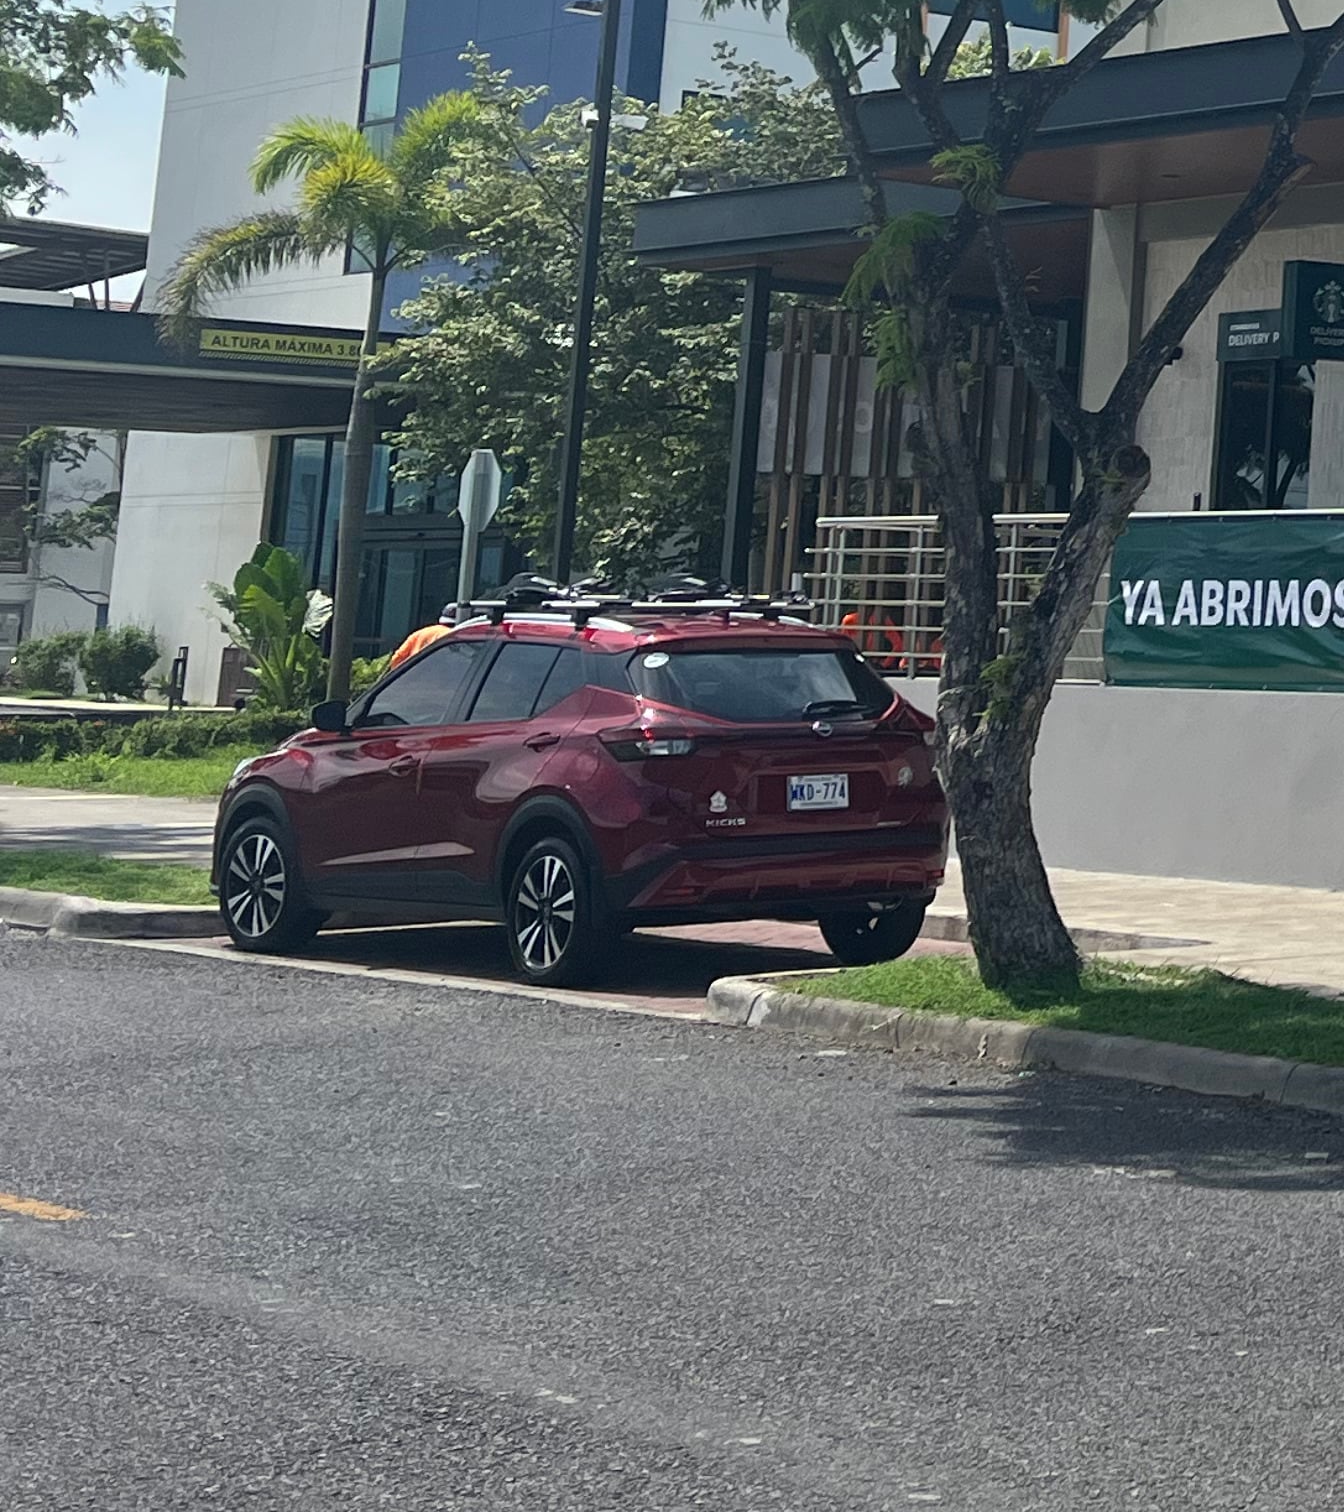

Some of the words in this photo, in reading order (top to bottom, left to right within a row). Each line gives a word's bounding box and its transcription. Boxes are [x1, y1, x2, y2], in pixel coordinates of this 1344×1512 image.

[211, 335, 271, 351] ALTURA
[1228, 332, 1271, 346] DELIVERY
[1120, 579, 1165, 625] YA
[706, 817, 746, 828] KICKS
